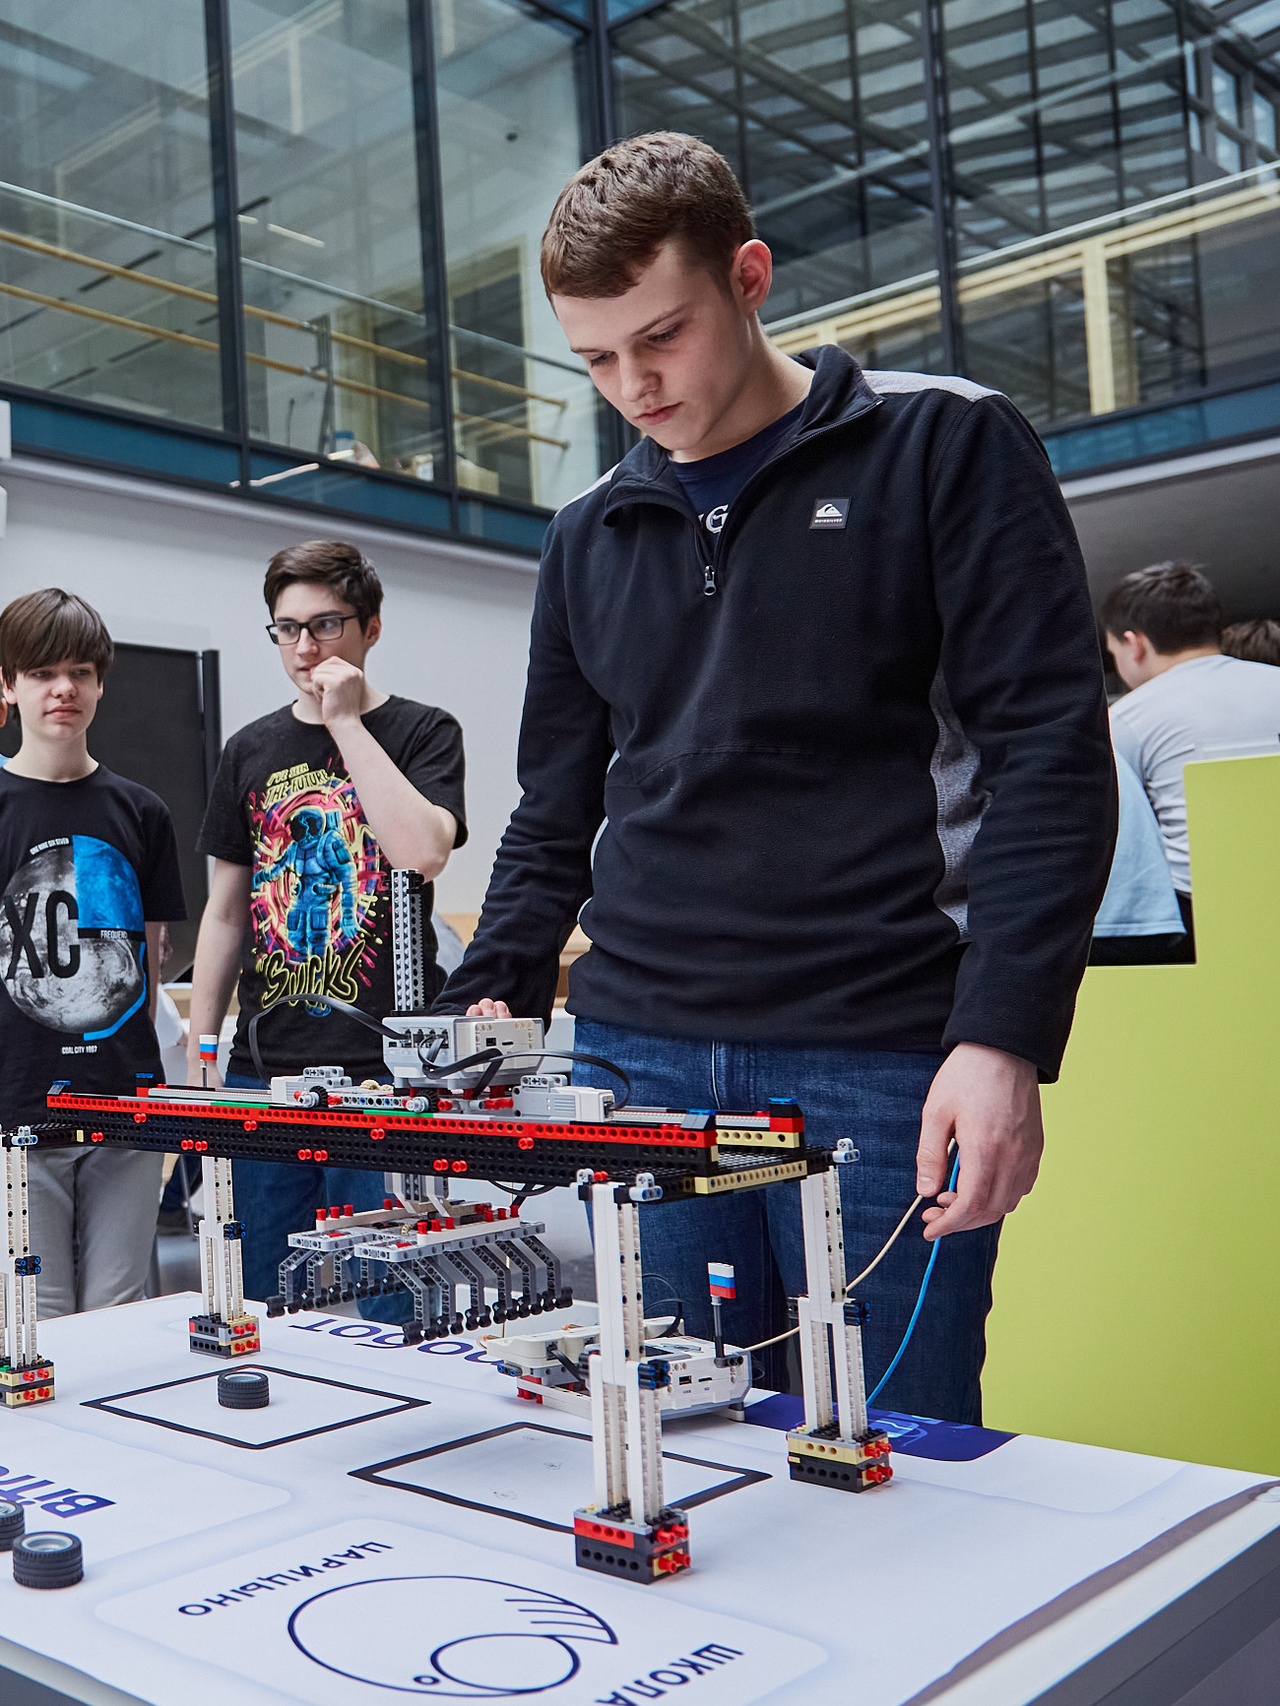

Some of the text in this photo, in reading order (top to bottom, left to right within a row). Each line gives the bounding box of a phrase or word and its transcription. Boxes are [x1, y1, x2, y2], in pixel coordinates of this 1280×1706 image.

[263, 768, 331, 810] THE FUTURE
[2, 889, 81, 980] XC
[178, 1541, 395, 1616] ЦАРИЦЫНО
[594, 1643, 745, 1706] ШКОЛА
